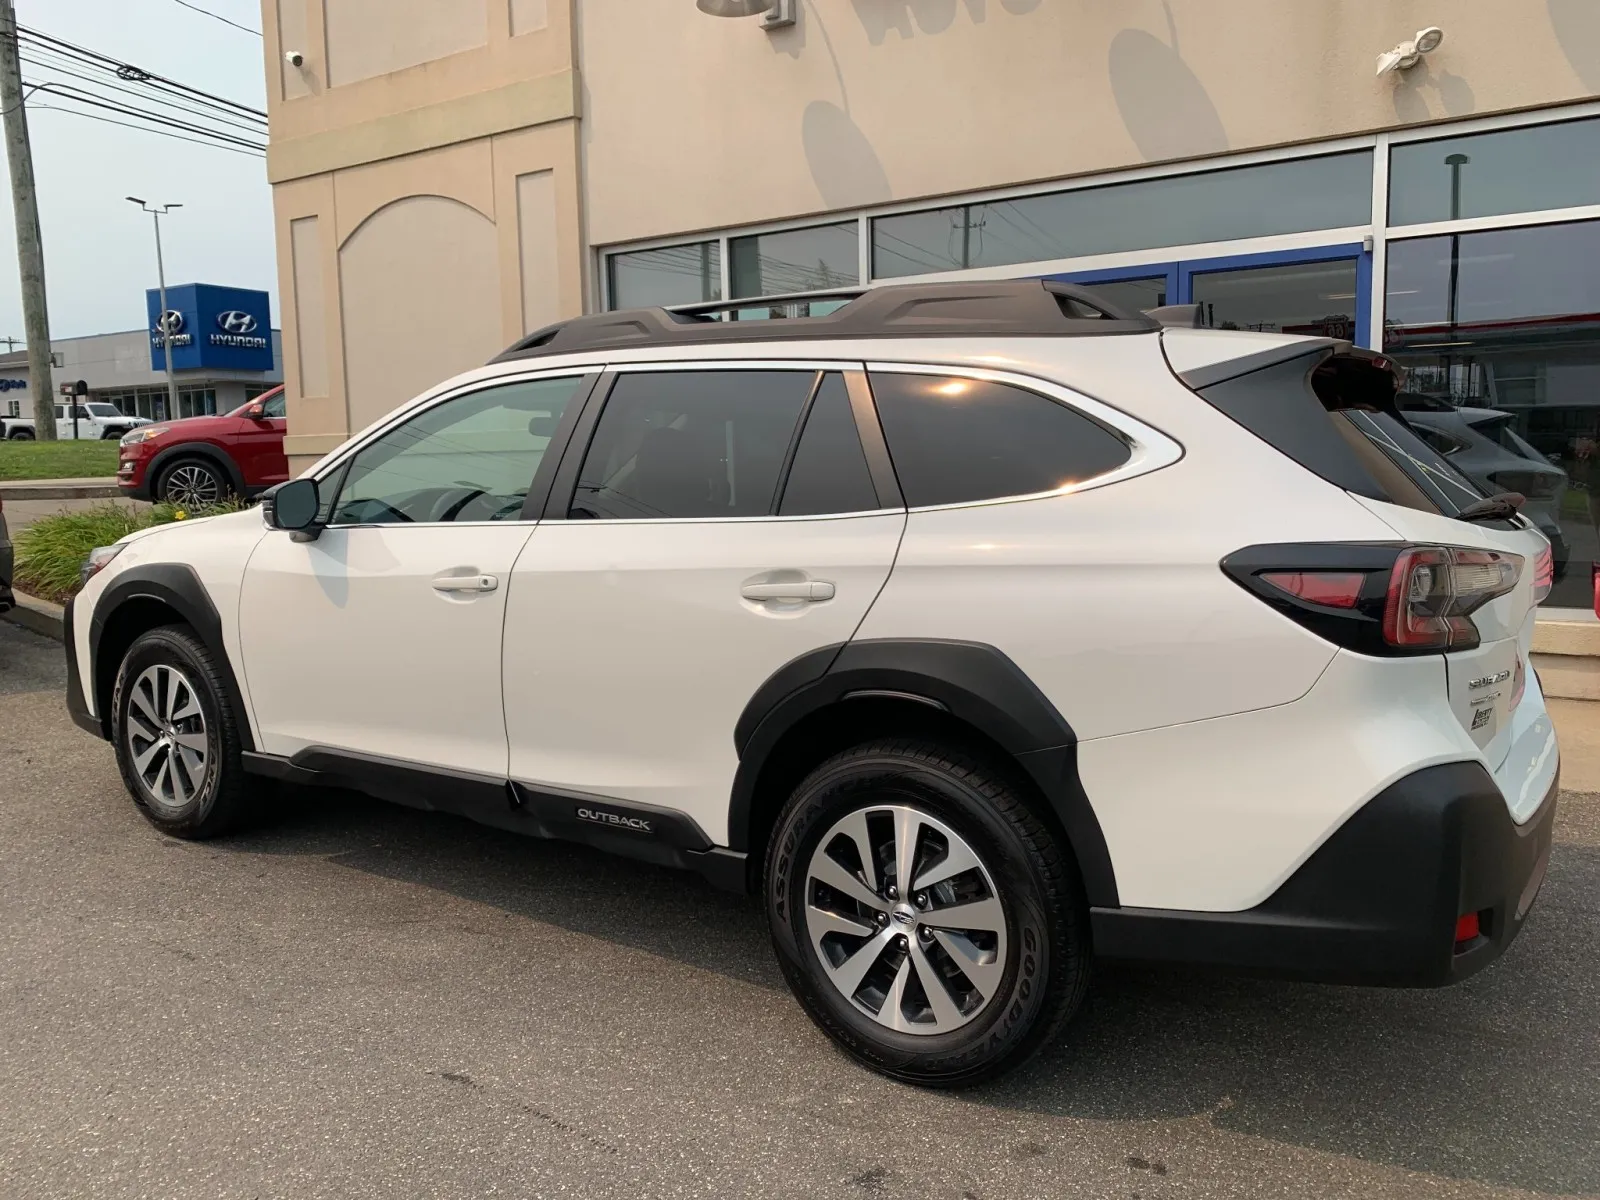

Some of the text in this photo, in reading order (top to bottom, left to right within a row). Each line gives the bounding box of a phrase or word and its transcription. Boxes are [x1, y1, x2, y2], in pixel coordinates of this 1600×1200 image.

[152, 334, 191, 347] HYNDAI
[210, 334, 266, 348] HYUNDAI
[577, 808, 651, 831] OUTBACK
